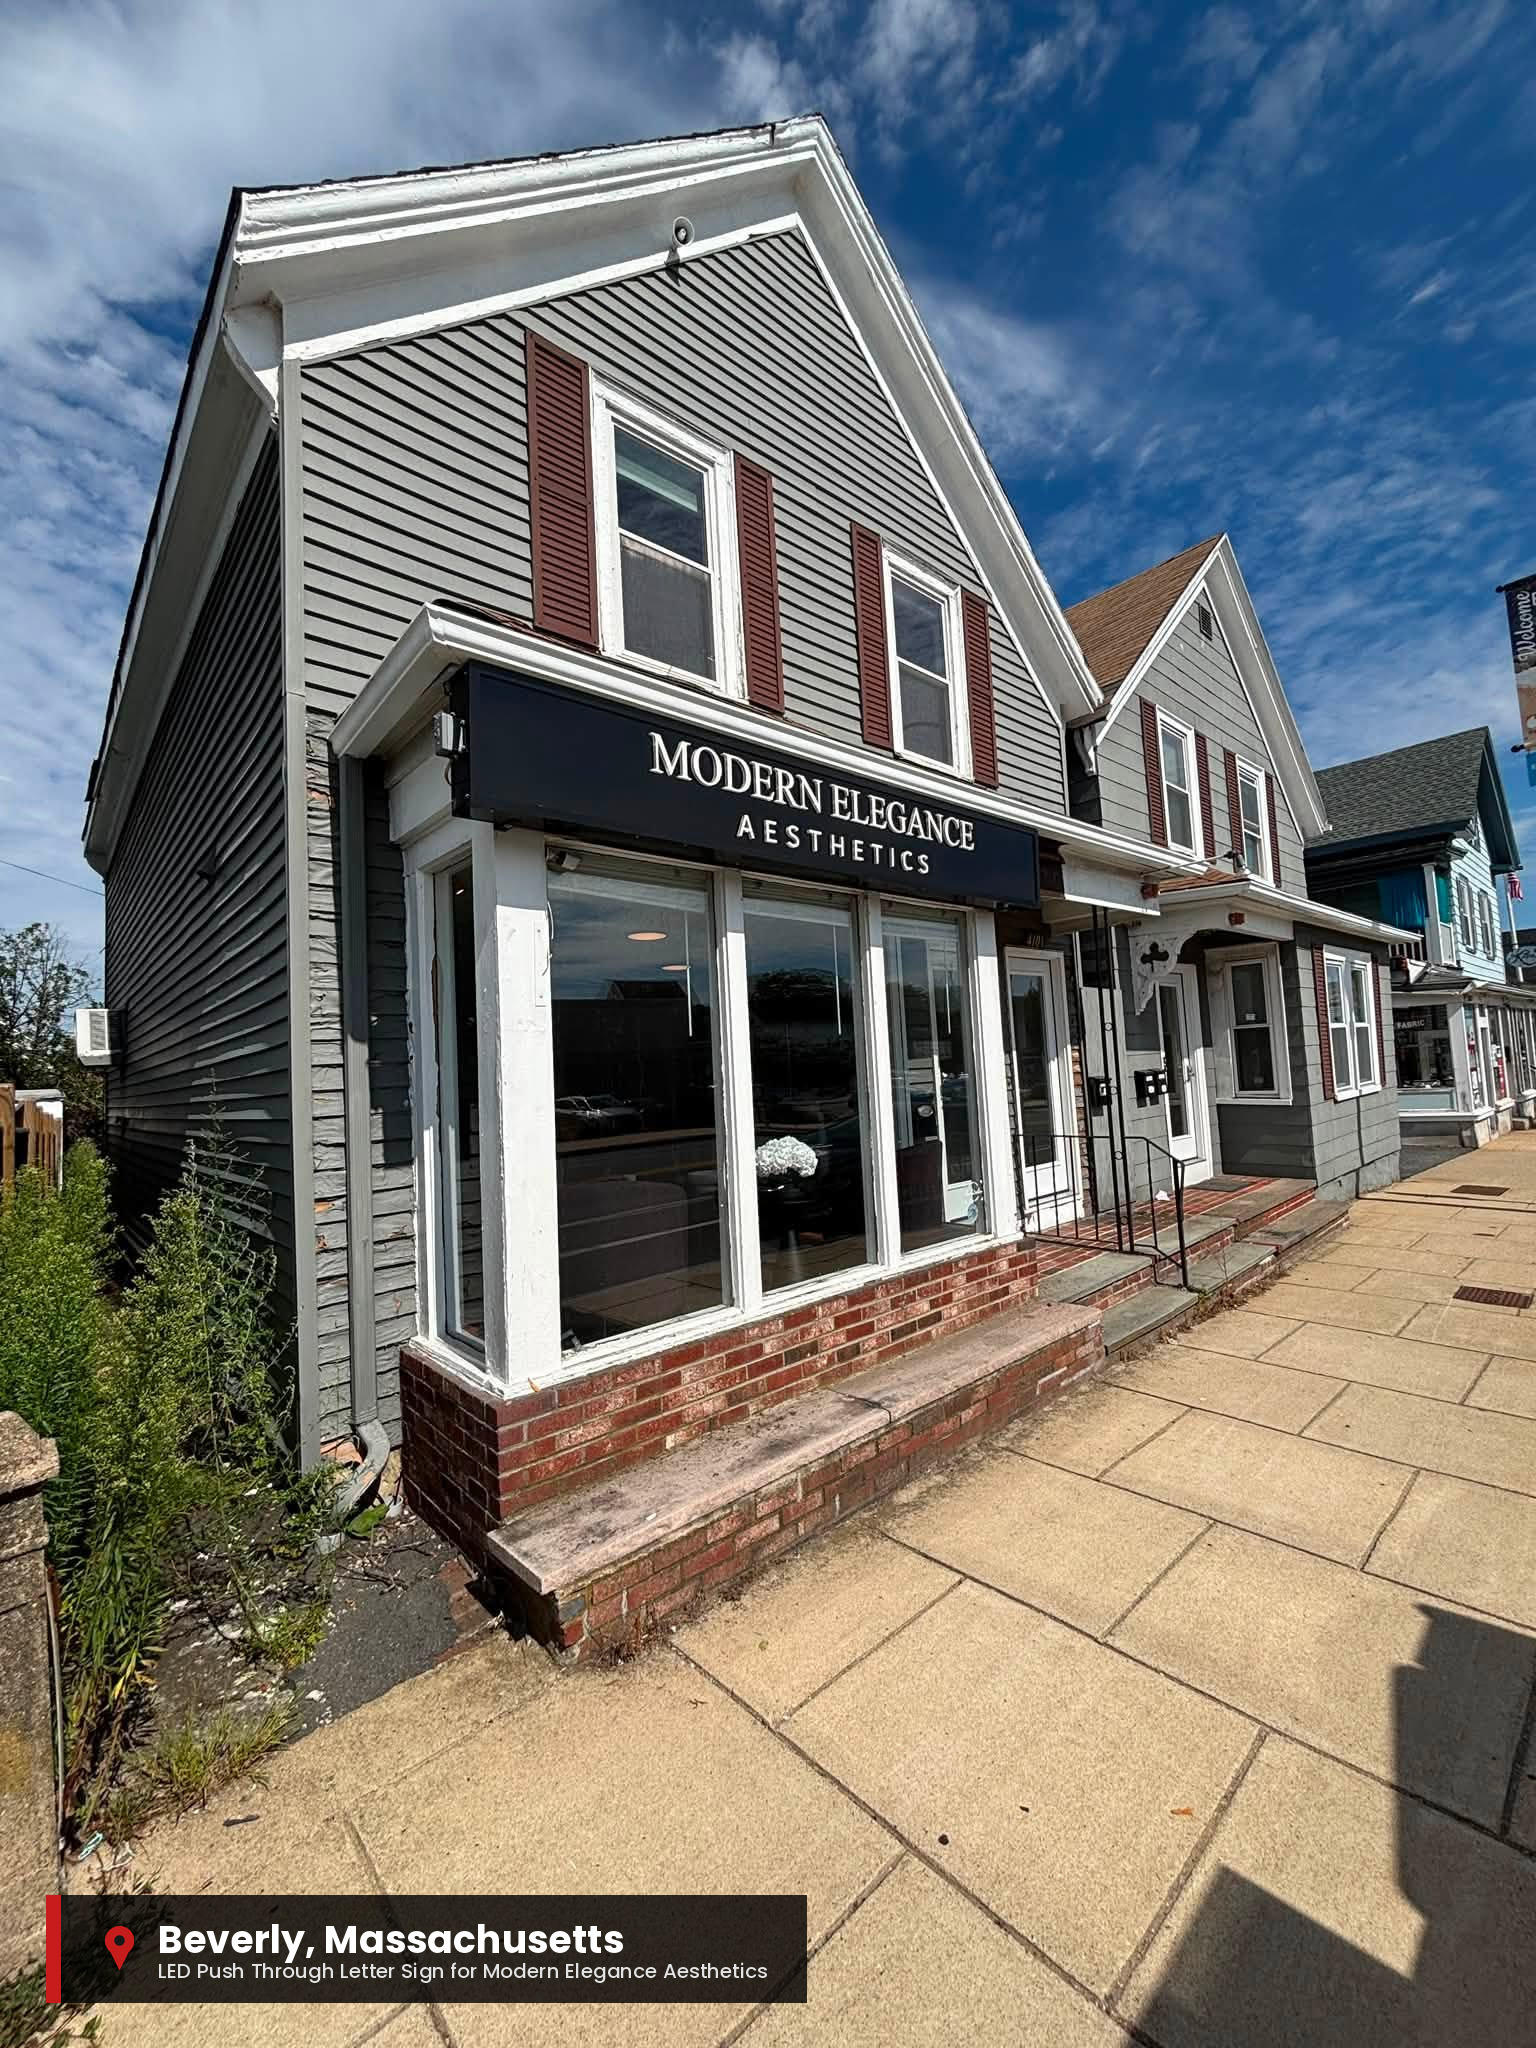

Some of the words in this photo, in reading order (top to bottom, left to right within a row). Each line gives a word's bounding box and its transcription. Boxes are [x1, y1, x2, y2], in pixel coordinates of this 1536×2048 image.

[1514, 591, 1536, 661] Welcome
[648, 731, 823, 815] MODERN
[829, 783, 976, 851] ELEGANCE
[736, 814, 930, 875] AESTHETICS
